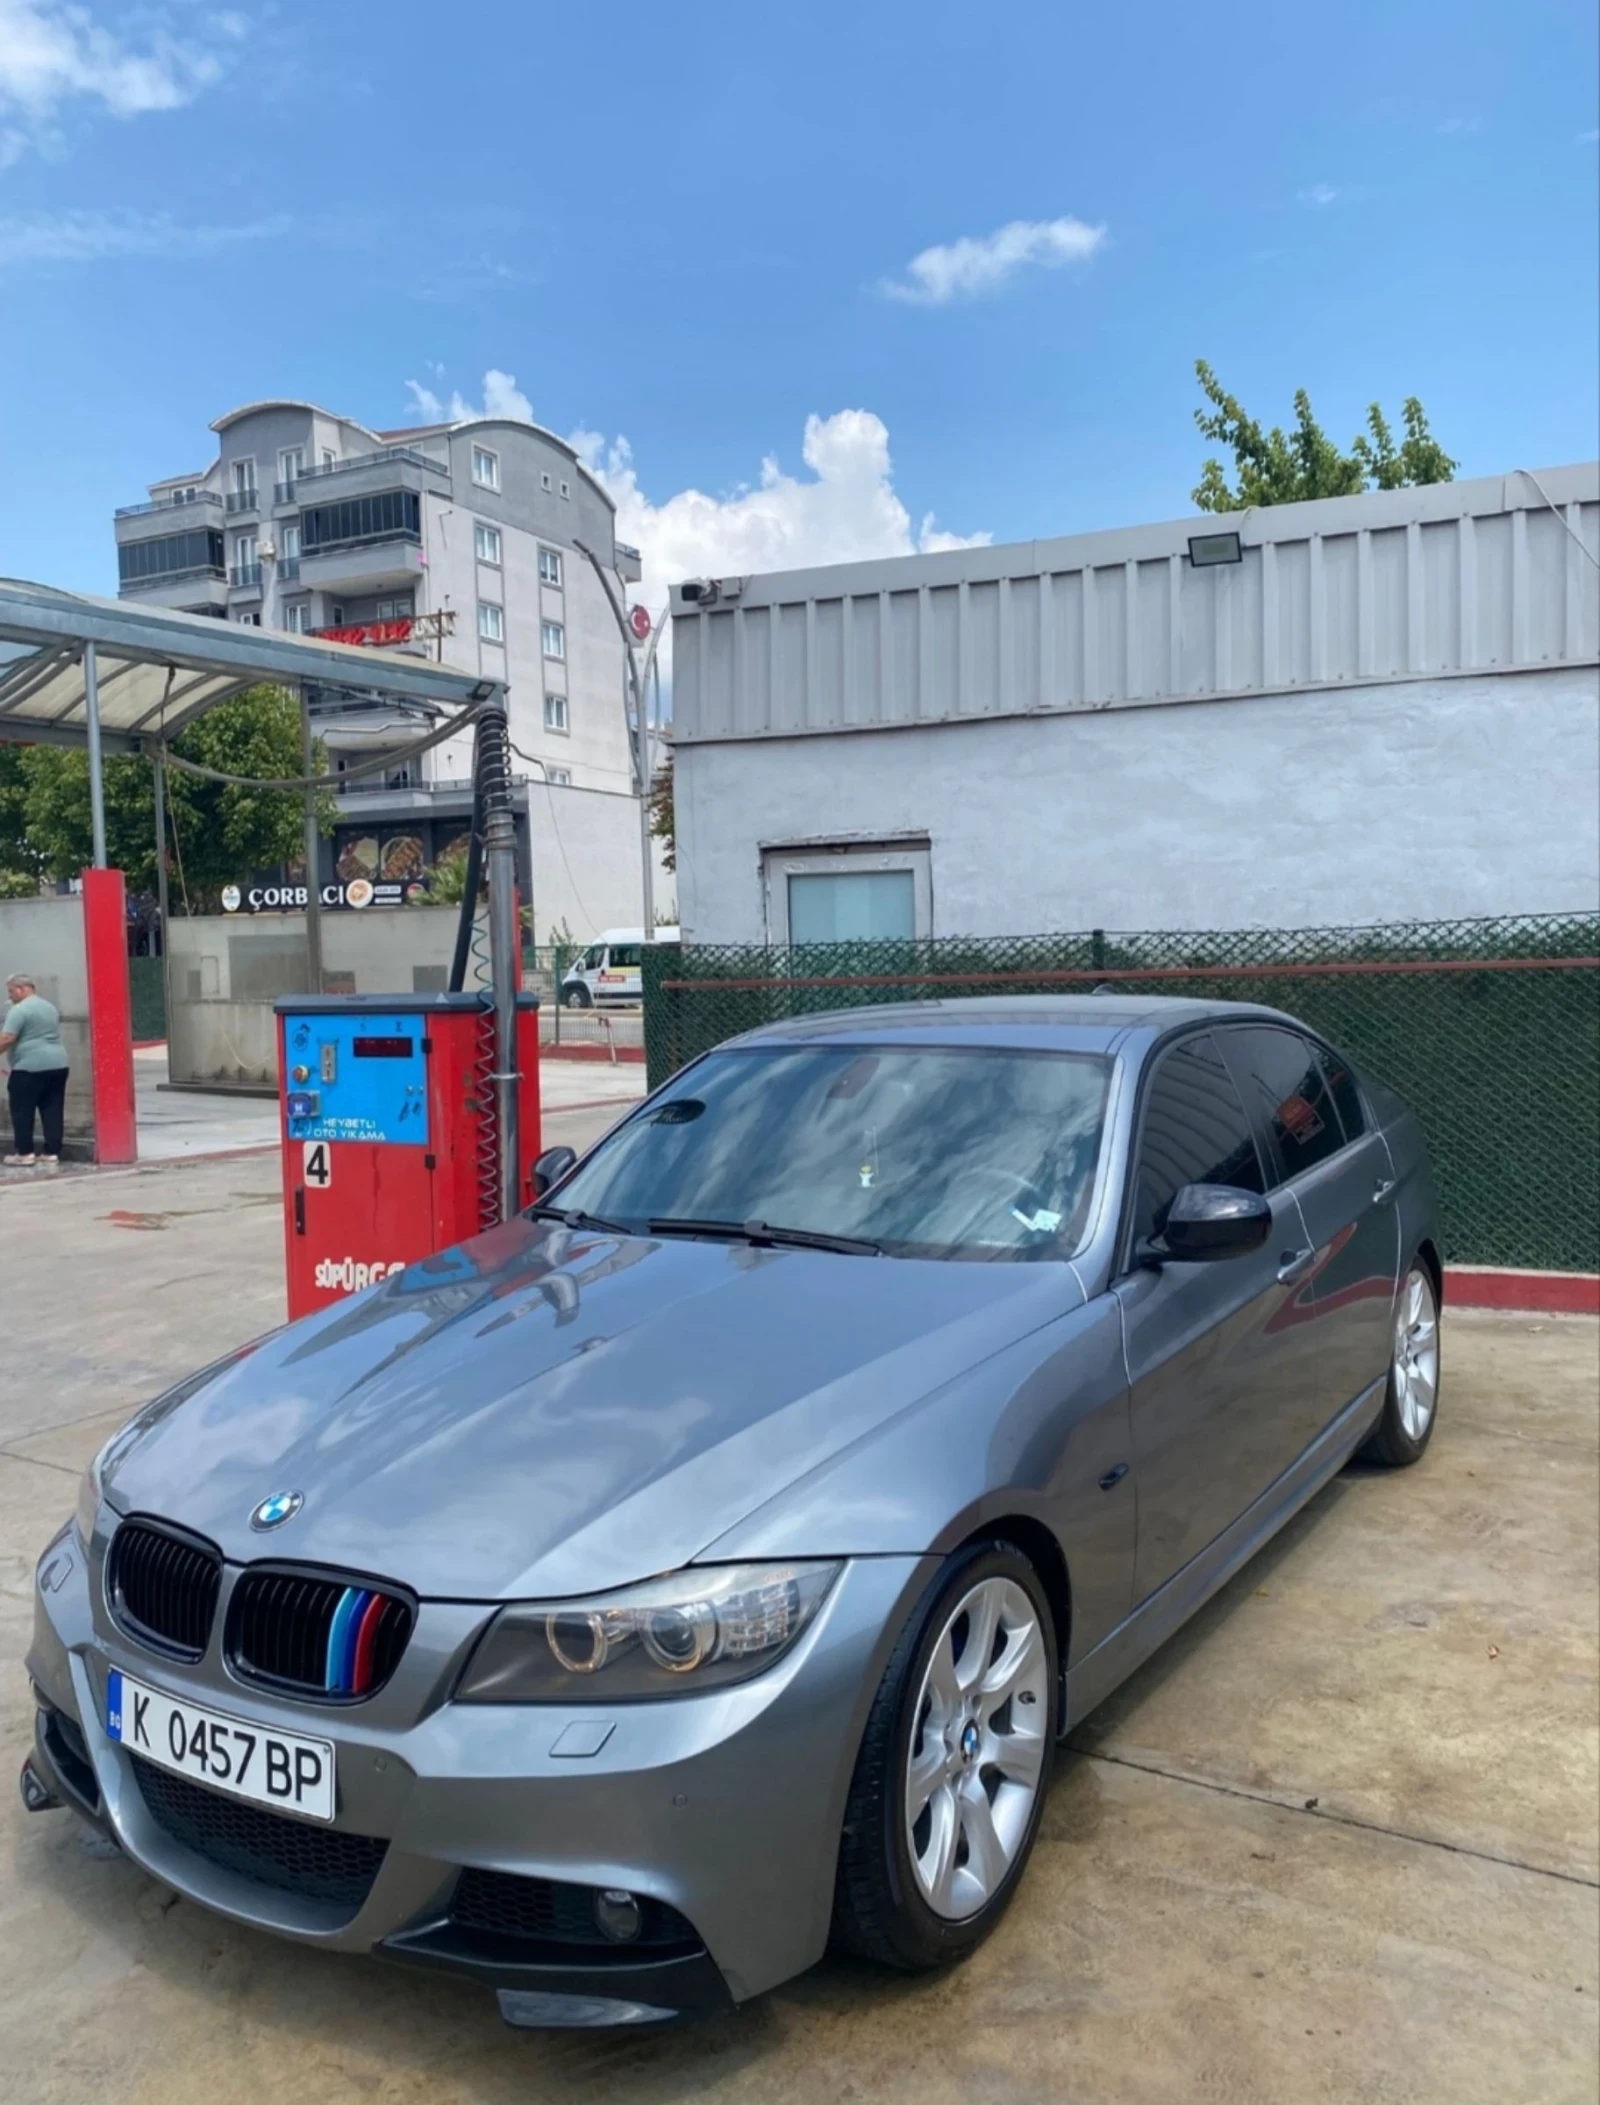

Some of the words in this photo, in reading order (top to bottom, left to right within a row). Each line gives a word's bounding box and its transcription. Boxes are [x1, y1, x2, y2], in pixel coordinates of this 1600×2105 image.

[249, 885, 344, 912] ÇORBCI
[313, 1128, 337, 1139] OTO
[341, 1130, 386, 1141] YIKAMA
[306, 1144, 329, 1185] 4
[134, 1691, 151, 1749] K
[168, 1709, 256, 1785] 0457
[265, 1739, 322, 1803] BP
